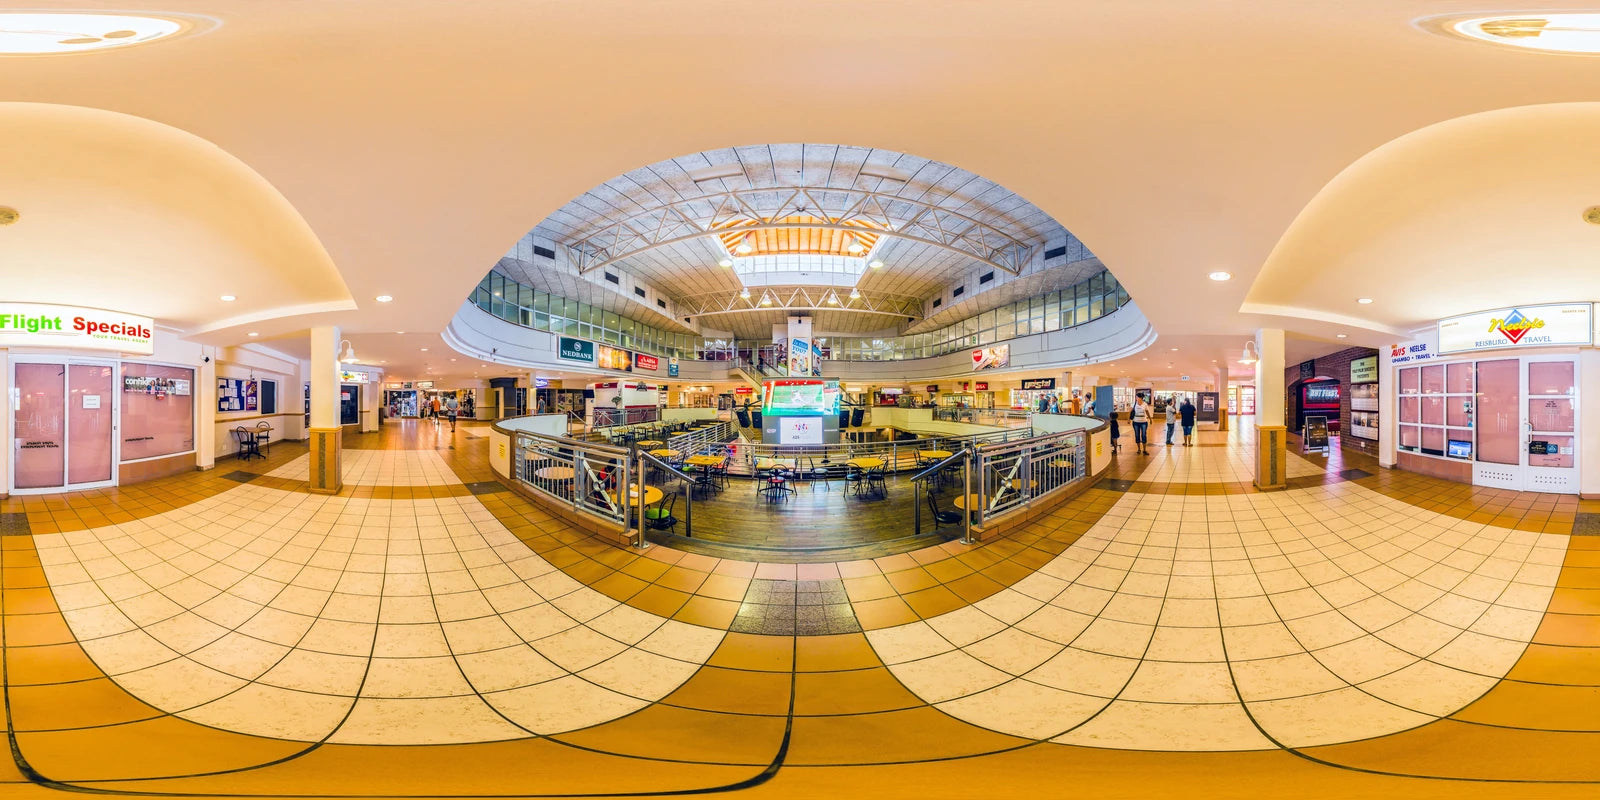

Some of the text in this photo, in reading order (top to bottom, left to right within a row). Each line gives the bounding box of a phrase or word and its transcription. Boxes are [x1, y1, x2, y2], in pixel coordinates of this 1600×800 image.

[0, 314, 151, 339] Flight Specials
[1488, 316, 1545, 332] Neelsie
[1475, 335, 1552, 347] REISBURO TRAVEL
[562, 350, 593, 359] NEDBANK
[1391, 347, 1405, 357] AVIS
[1409, 344, 1427, 353] NEELSIE
